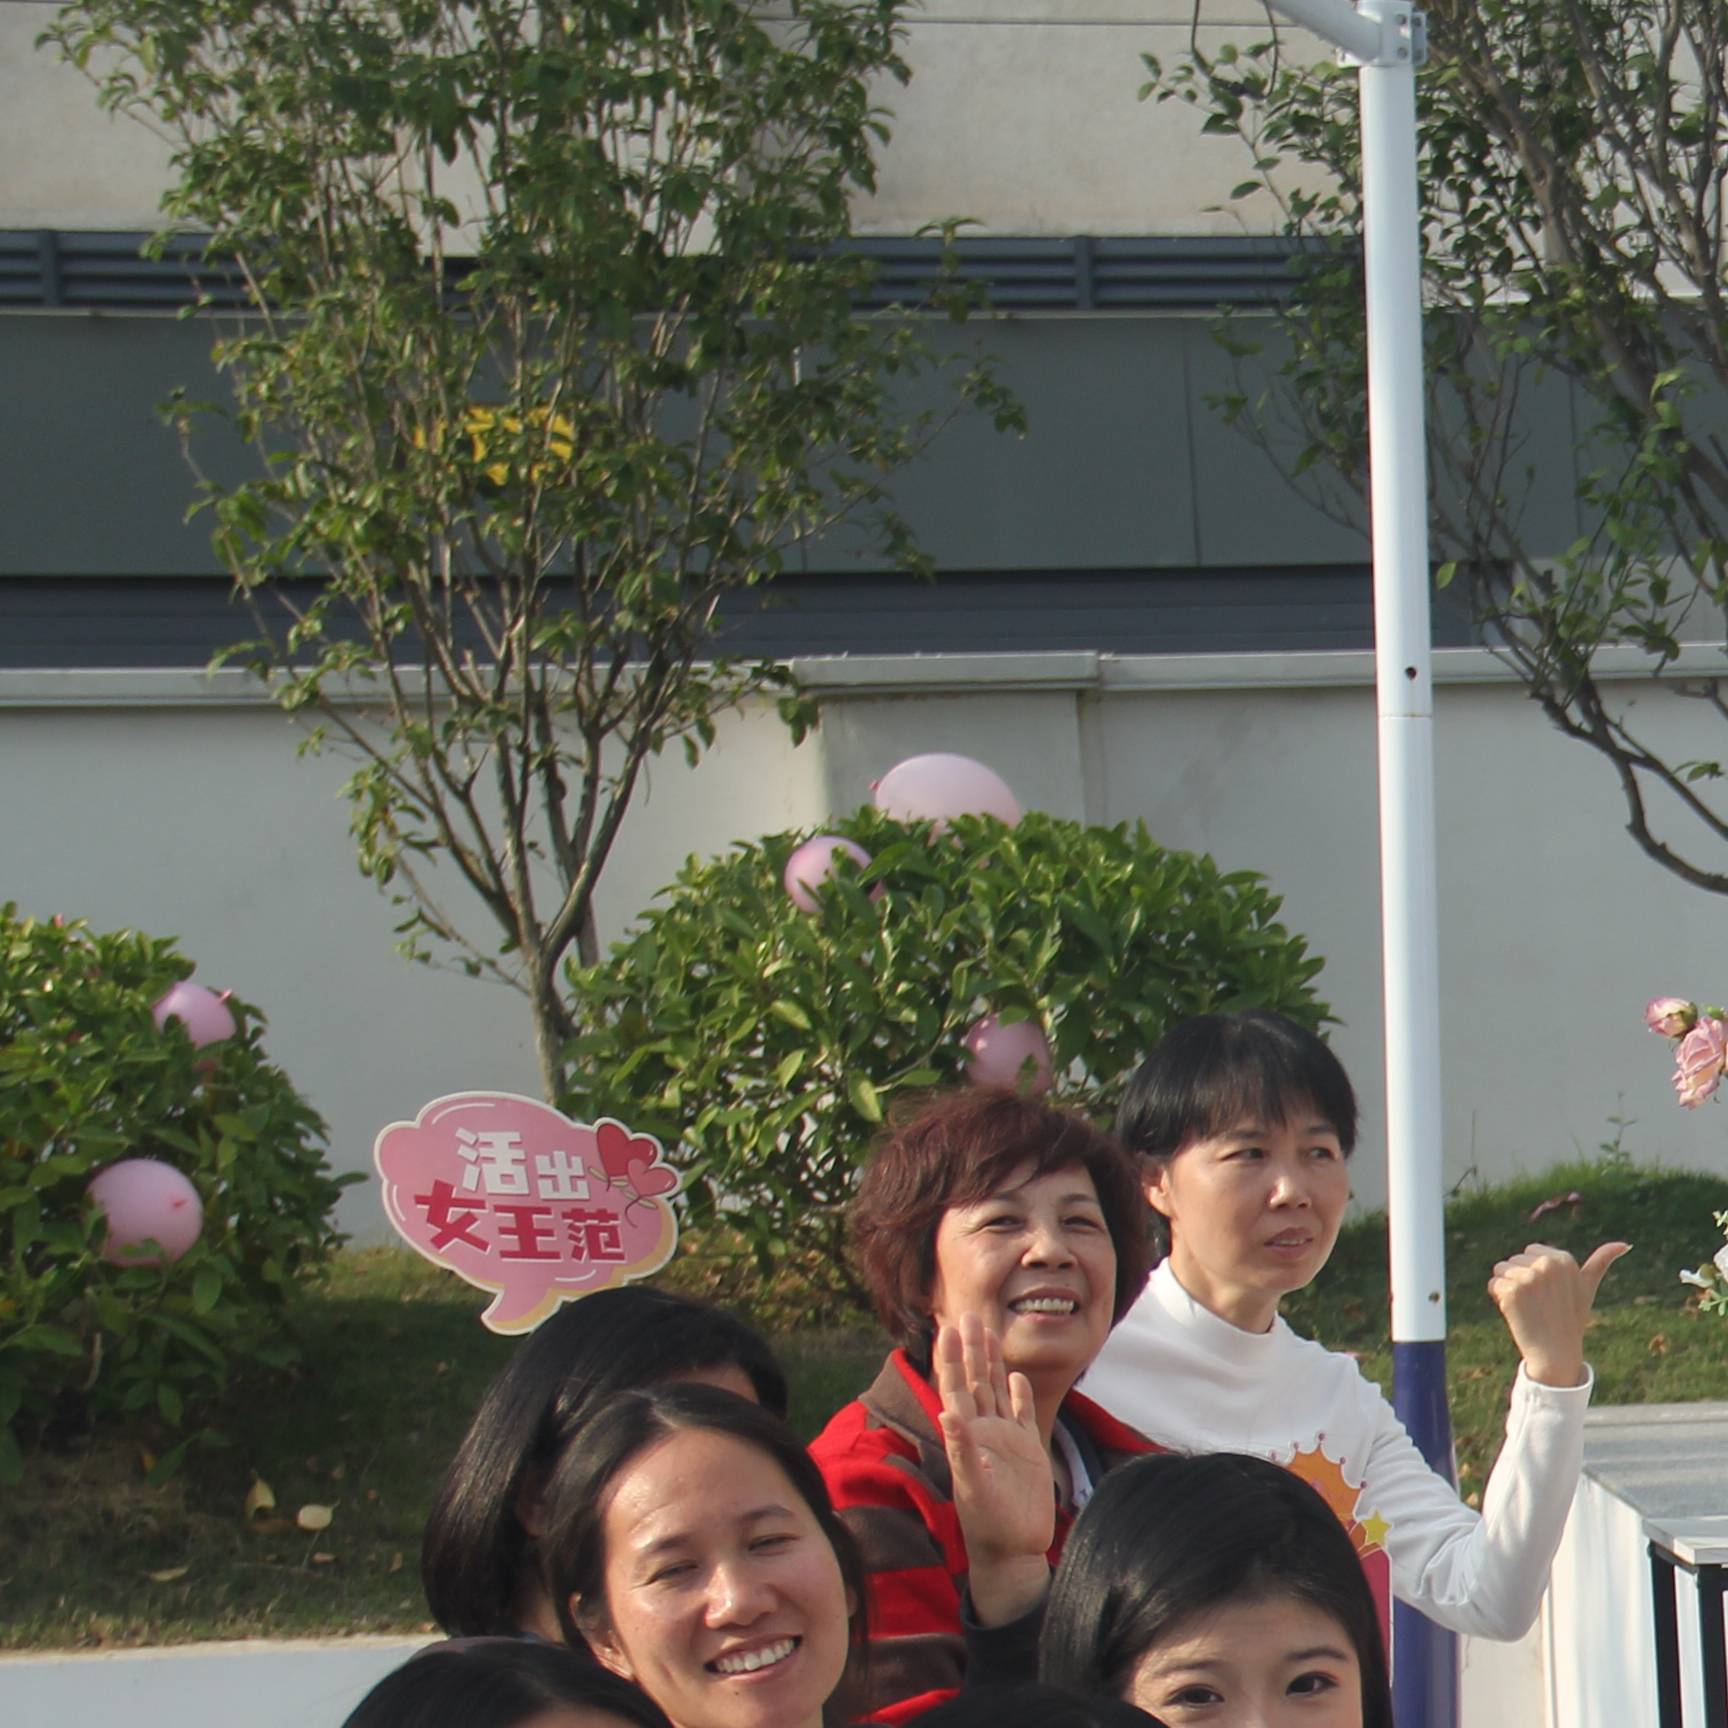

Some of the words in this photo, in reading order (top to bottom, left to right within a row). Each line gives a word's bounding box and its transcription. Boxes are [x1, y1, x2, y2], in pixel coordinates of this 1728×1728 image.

[456, 1127, 591, 1201] 活出
[413, 1178, 626, 1263] 女王范
